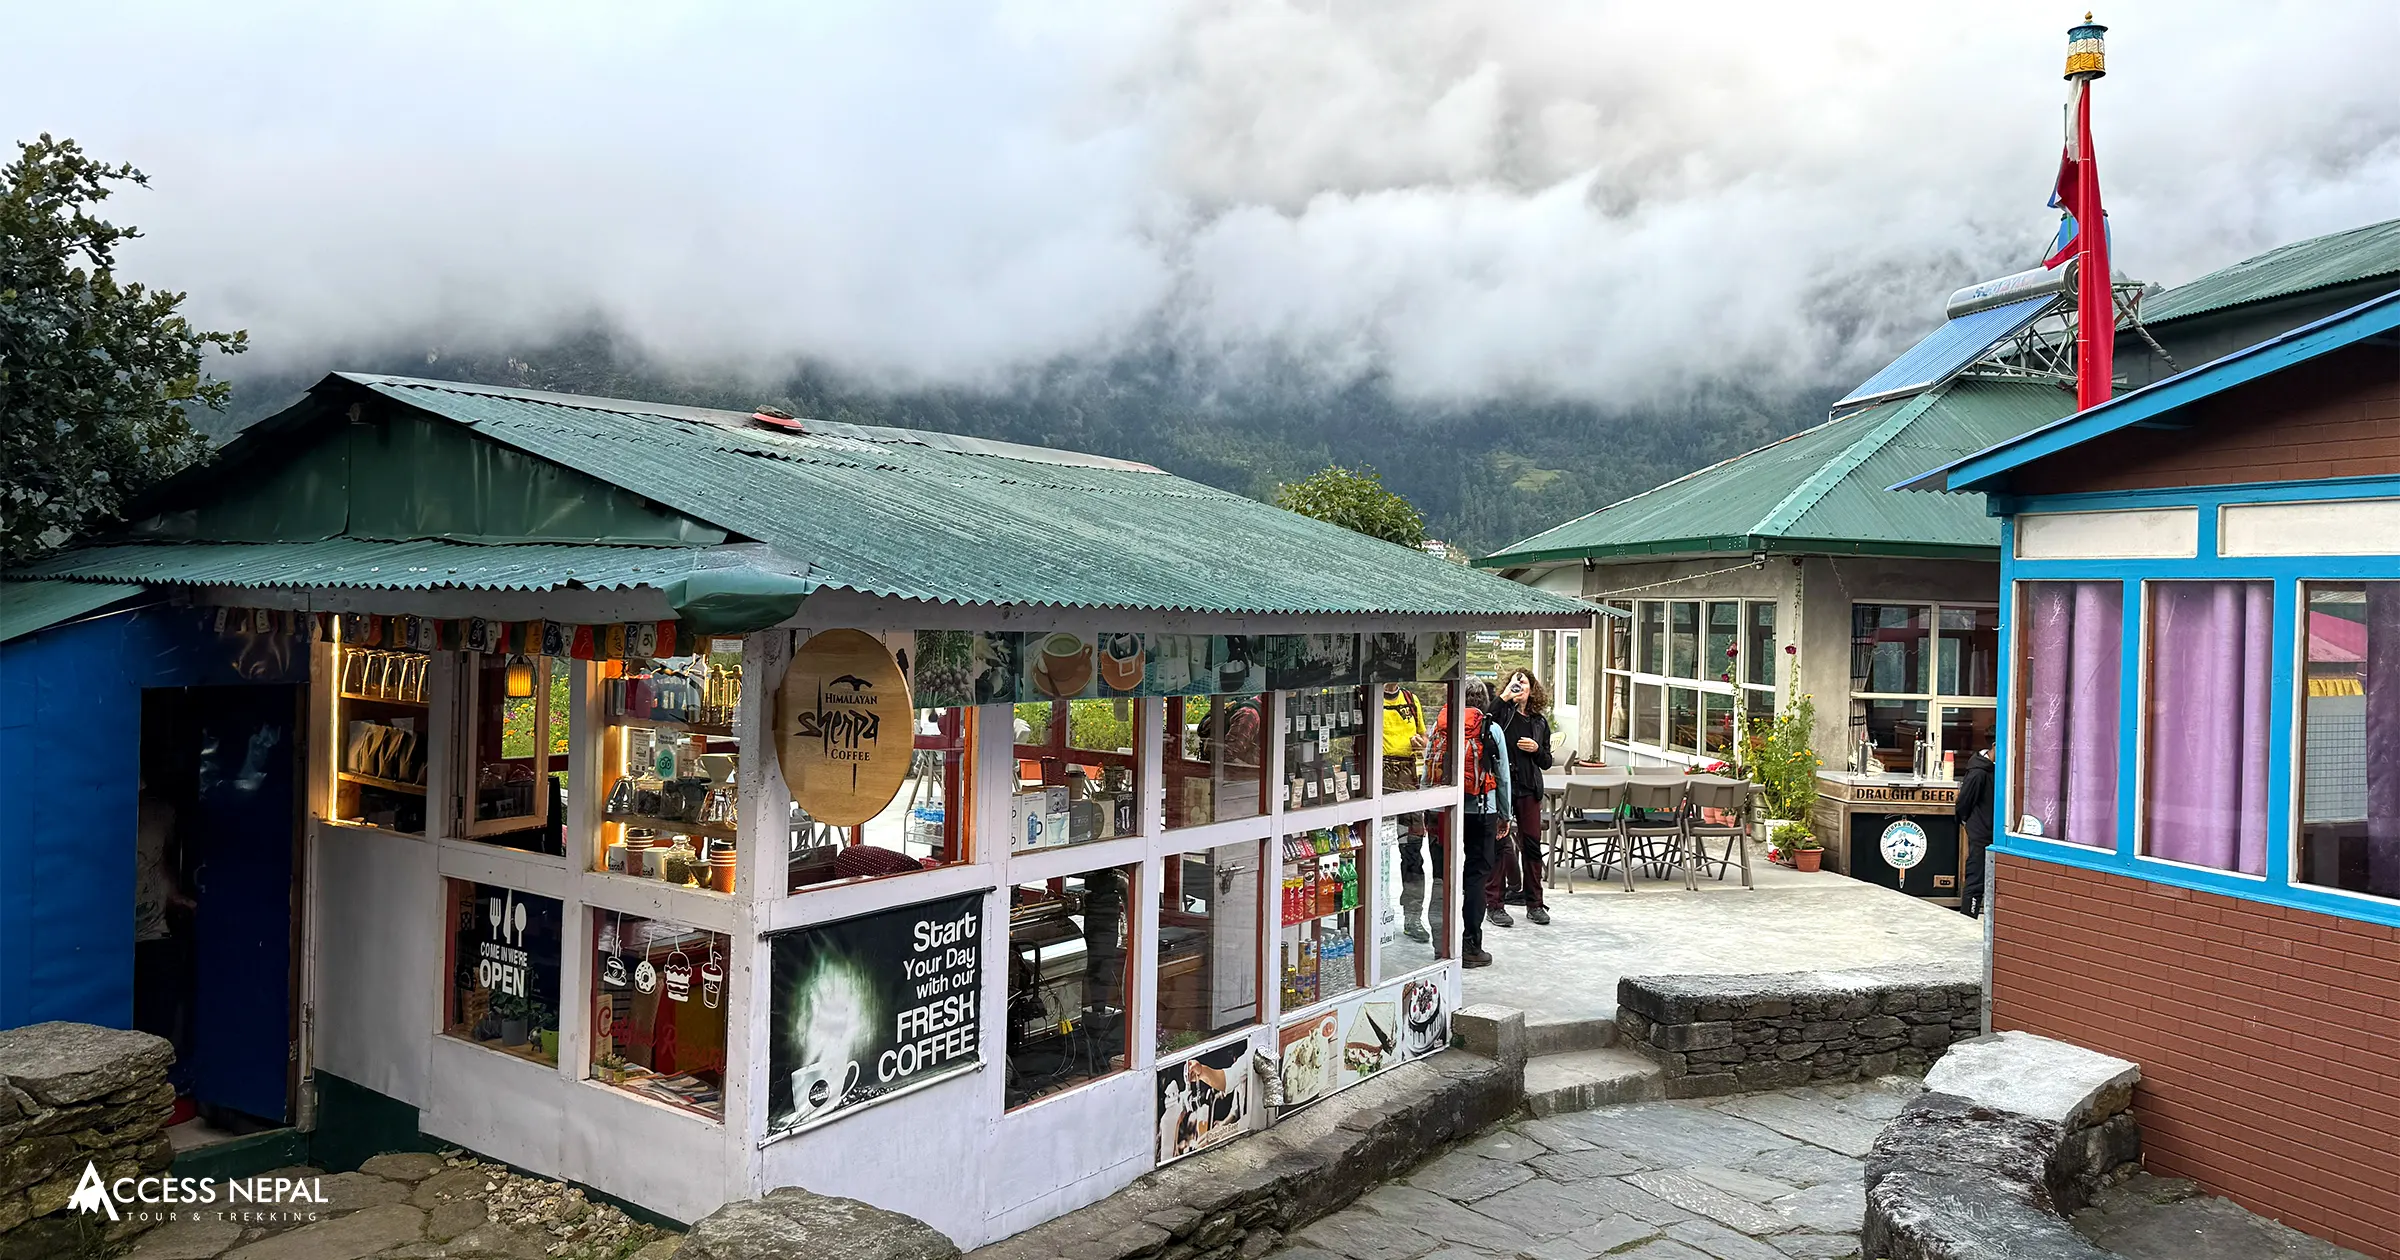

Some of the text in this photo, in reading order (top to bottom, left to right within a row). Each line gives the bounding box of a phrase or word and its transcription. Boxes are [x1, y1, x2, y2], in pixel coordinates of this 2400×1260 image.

[825, 693, 878, 705] HIMALAYAN
[831, 748, 871, 761] COFFEE
[1856, 788, 1955, 801] DRAUGHT BEER
[1883, 822, 1902, 839] SHERPA
[913, 911, 976, 953] Start
[480, 941, 500, 960] COME
[501, 946, 508, 962] IN
[903, 946, 976, 981] Your Day
[479, 958, 525, 998] OPEN
[916, 969, 976, 1000] with our
[896, 990, 976, 1044] FRESH
[877, 1022, 976, 1083] COFFEE
